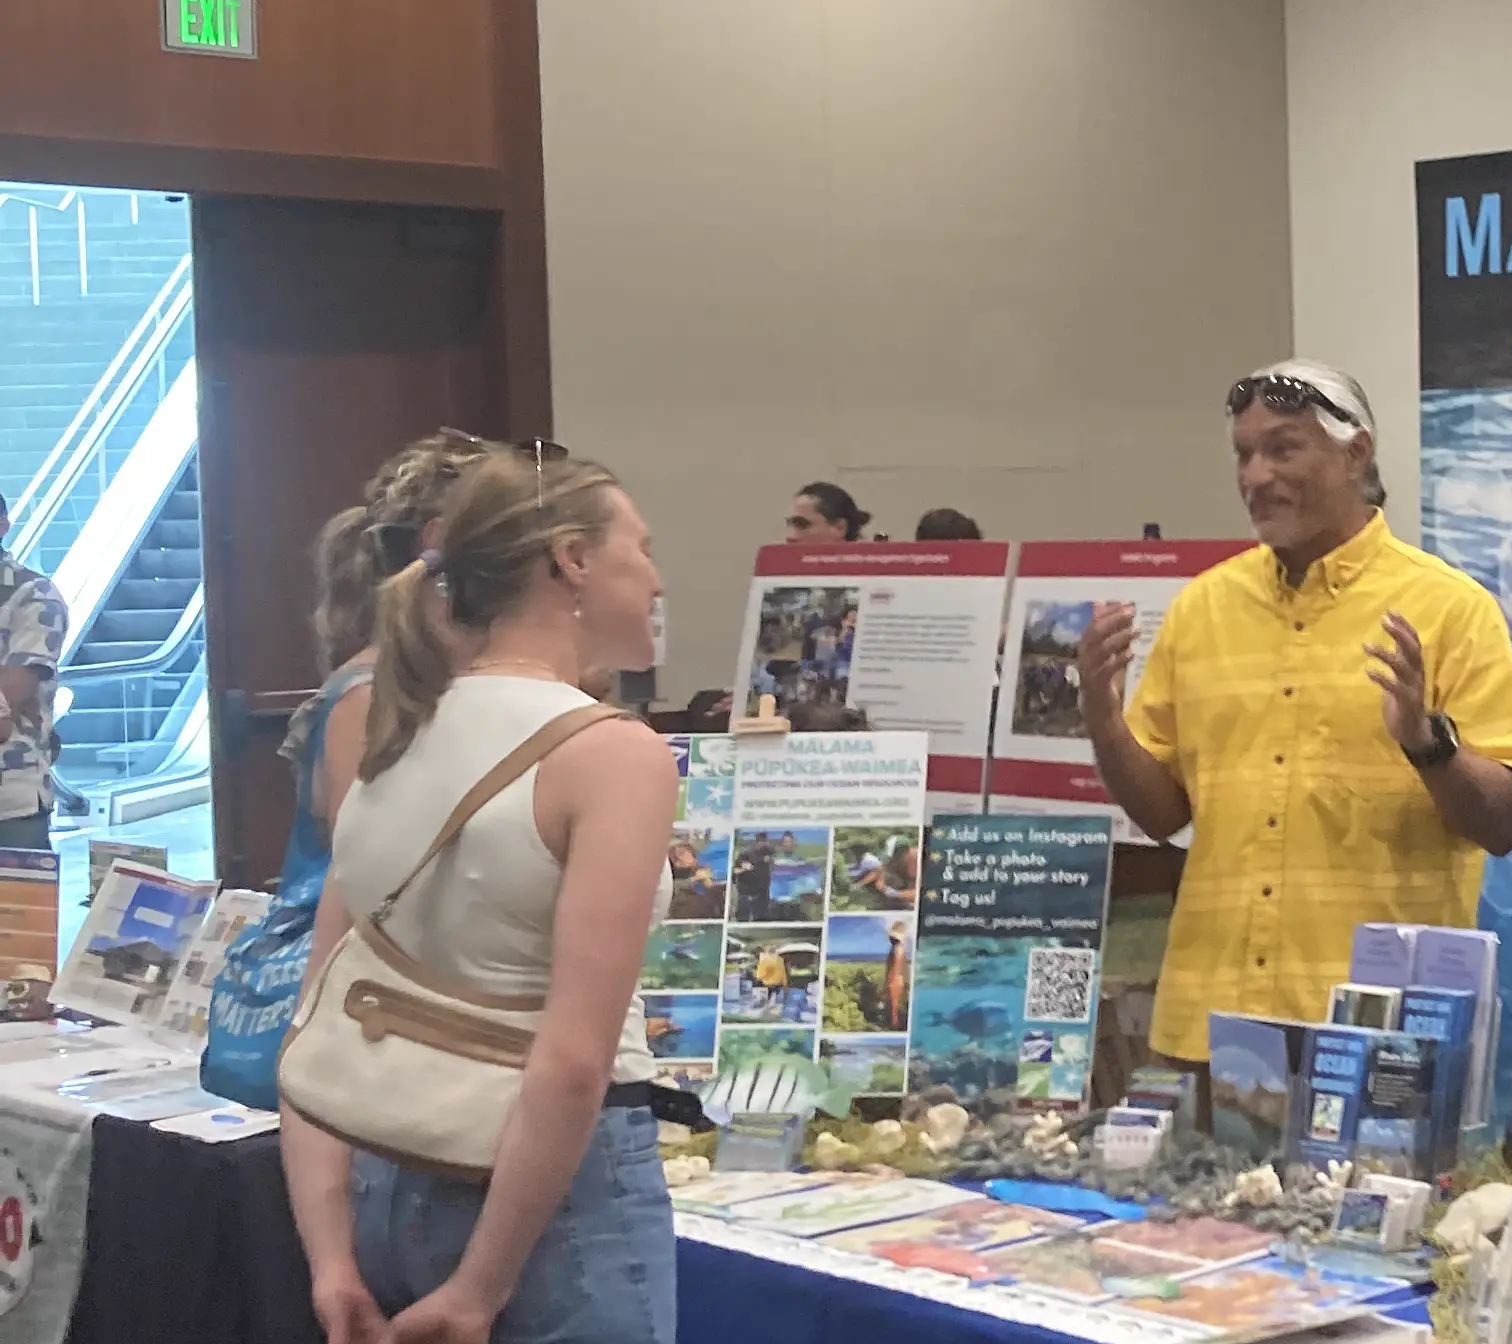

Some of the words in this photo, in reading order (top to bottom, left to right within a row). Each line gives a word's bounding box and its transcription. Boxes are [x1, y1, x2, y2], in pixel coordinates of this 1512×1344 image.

[946, 824, 979, 843] Add
[982, 831, 1000, 843] us
[1003, 831, 1024, 844] on
[1028, 826, 1109, 848] Instagram
[944, 848, 982, 866] Take
[985, 854, 997, 866] a
[1000, 849, 1047, 870] photo
[941, 865, 955, 882] &
[958, 866, 990, 883] add
[993, 868, 1009, 884] to
[1012, 870, 1047, 887] your
[1050, 867, 1090, 888] story
[940, 887, 971, 909] Tag
[974, 889, 997, 906] us!
